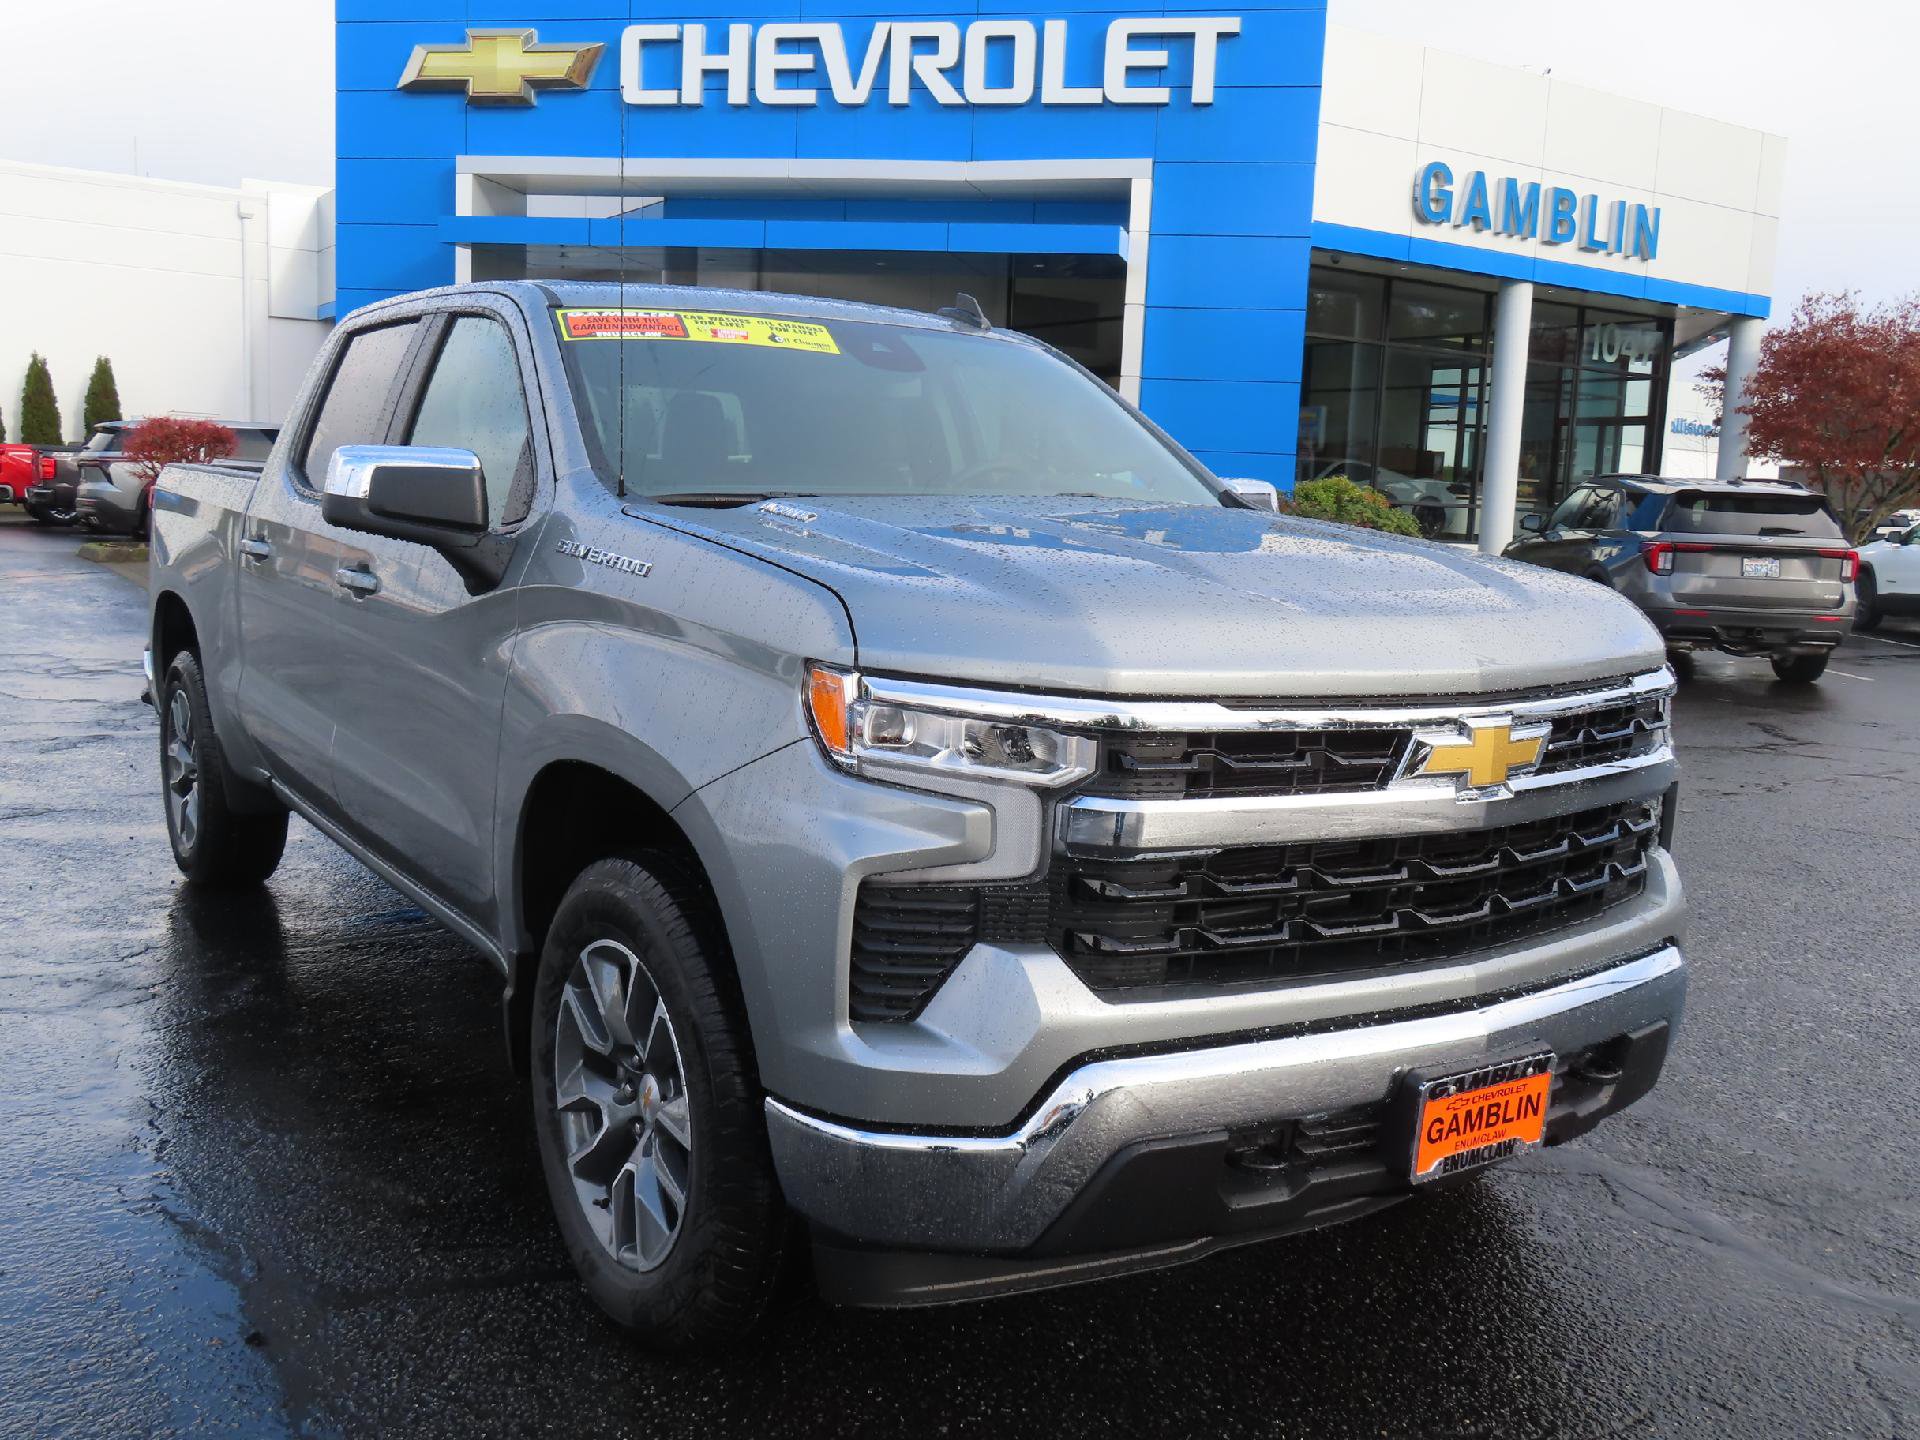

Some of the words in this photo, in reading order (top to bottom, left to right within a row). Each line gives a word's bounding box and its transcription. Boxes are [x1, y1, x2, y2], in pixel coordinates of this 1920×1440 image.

[620, 17, 1242, 106] CHEVROLET
[1413, 161, 1660, 262] GAMBLIN
[572, 323, 619, 331] GAMBLIN
[621, 323, 680, 332] ADVANTAGE
[708, 316, 752, 325] WASHES
[768, 324, 789, 332] FOR
[556, 539, 653, 577] SILVERADO
[1471, 1083, 1529, 1105] CHEVROLET
[1426, 1092, 1542, 1145] GAMBLIN
[1454, 1129, 1507, 1151] ENUMCLAW
[1441, 1138, 1515, 1172] ENUMCLAW
